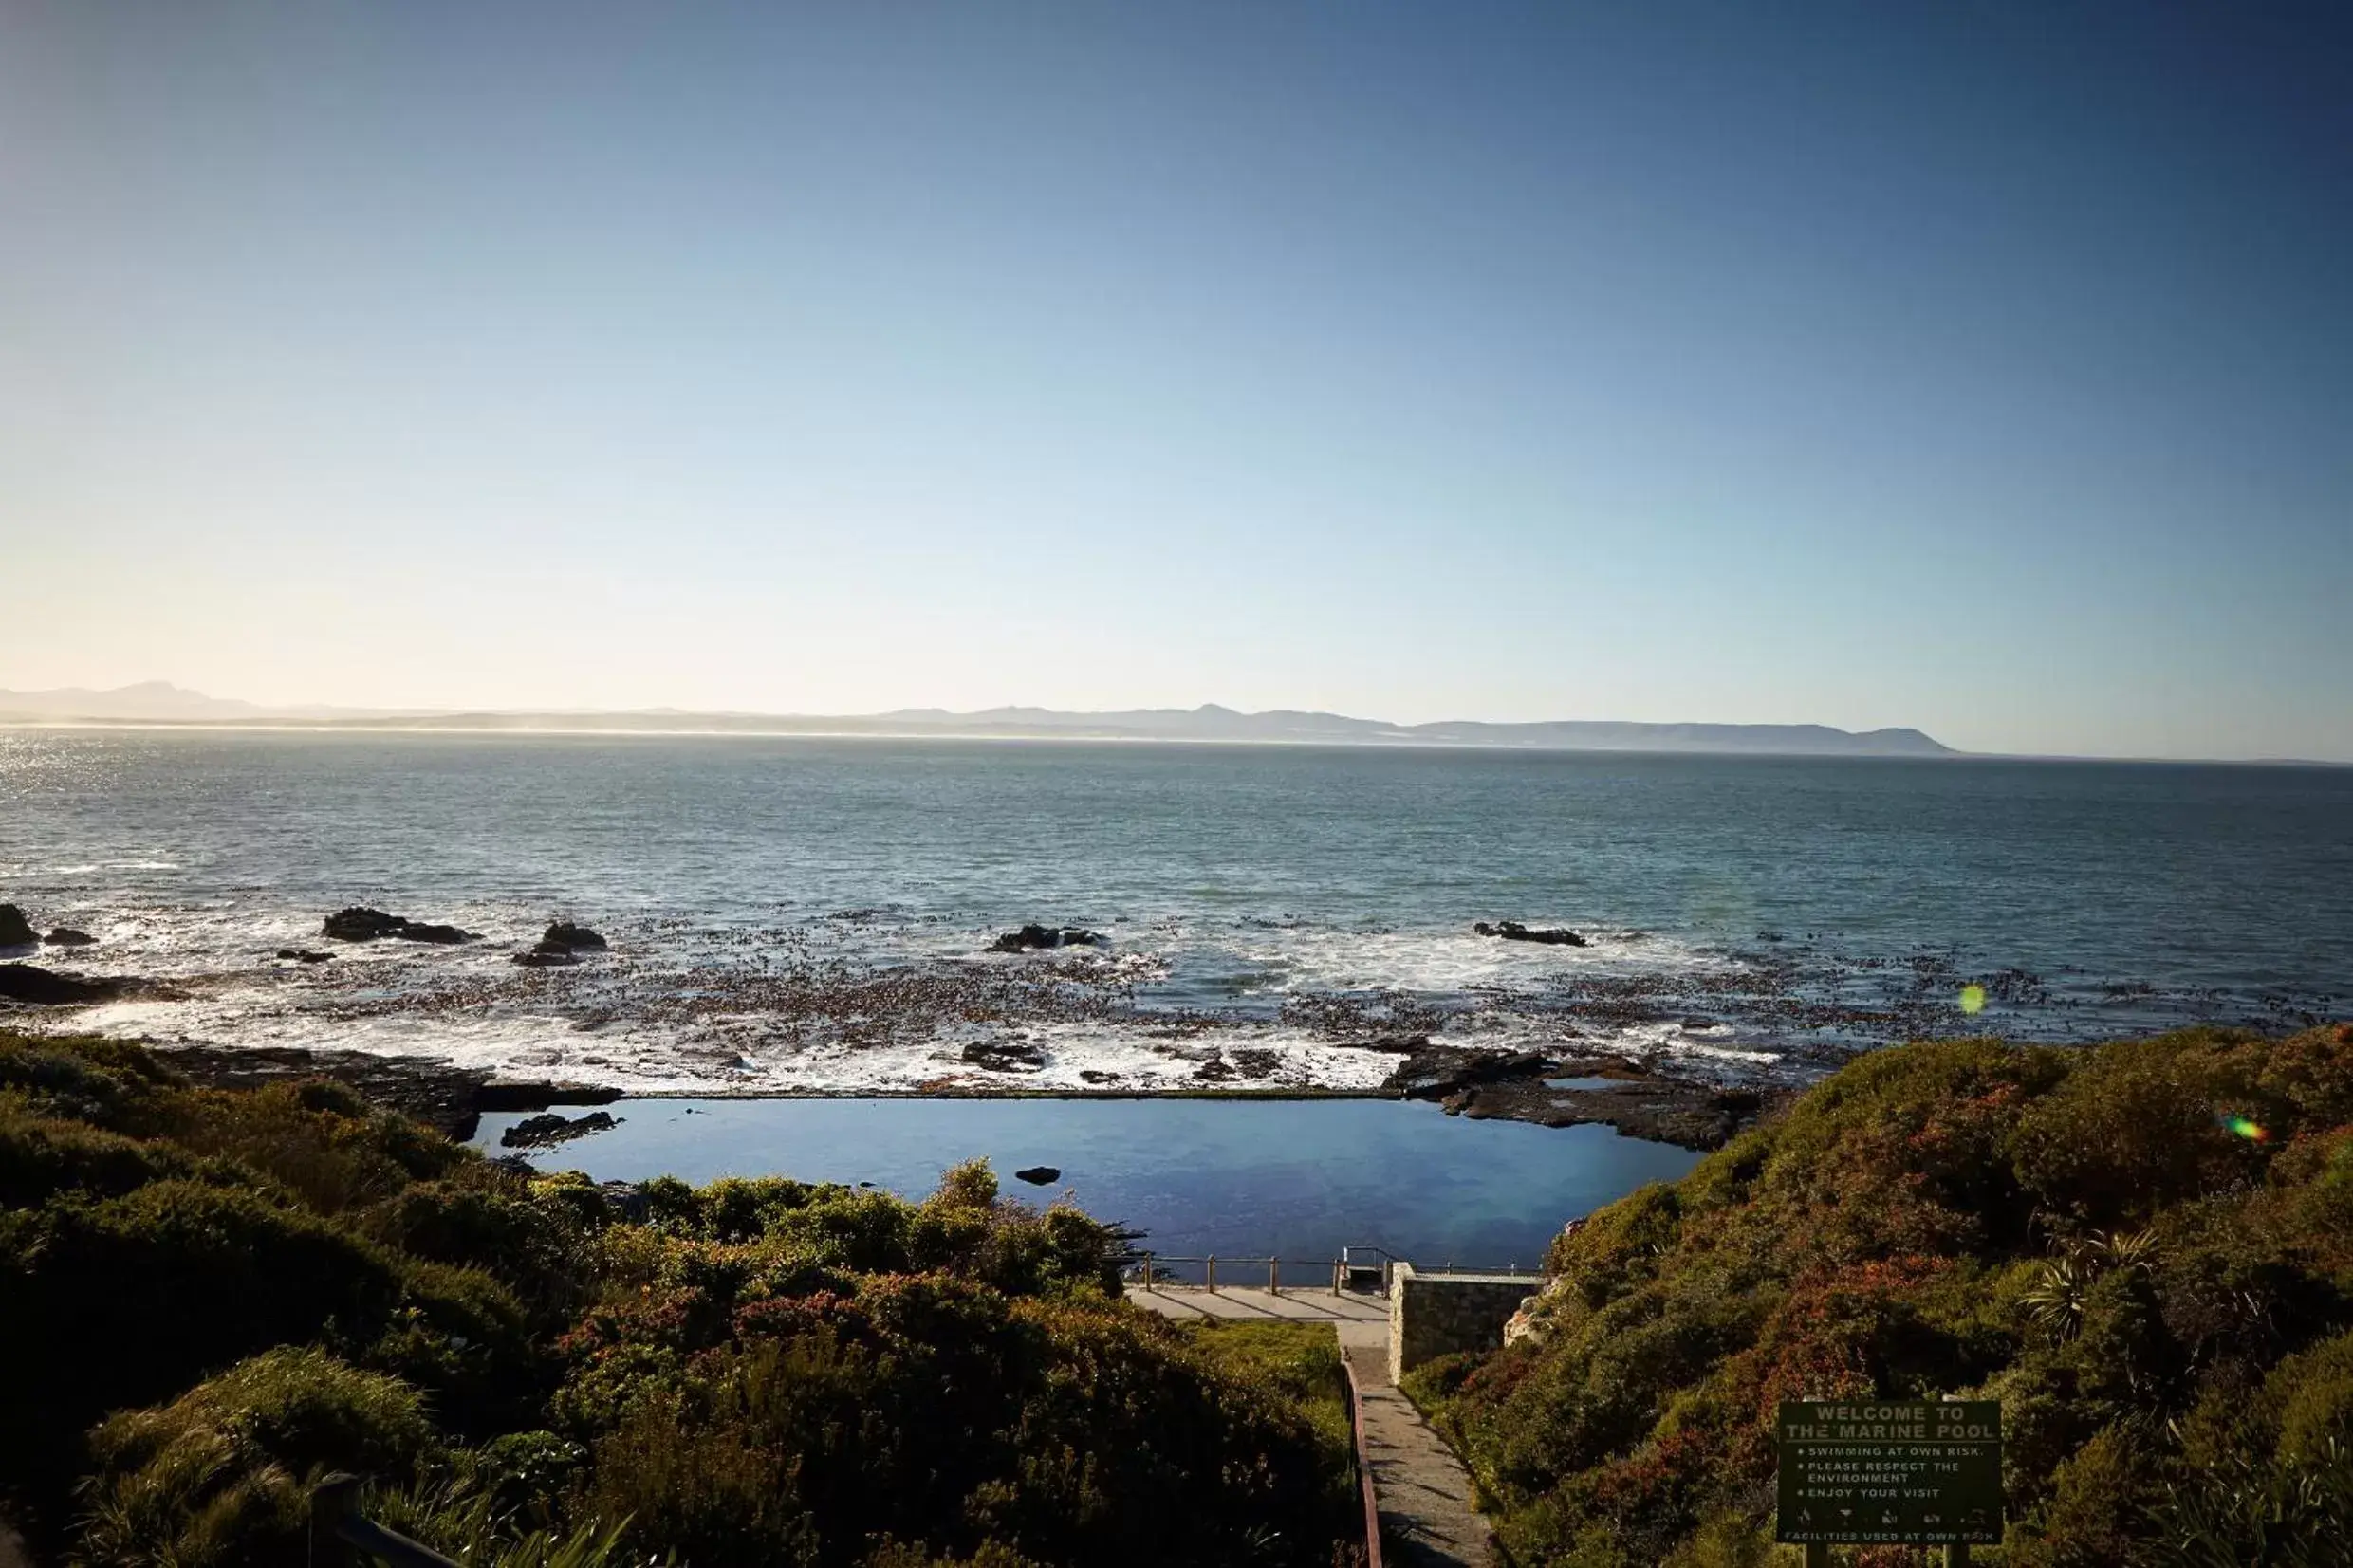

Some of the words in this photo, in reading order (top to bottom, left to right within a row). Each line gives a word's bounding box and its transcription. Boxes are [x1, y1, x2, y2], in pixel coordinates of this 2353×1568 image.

[1817, 1406, 1927, 1421] WELCOME
[1937, 1407, 1964, 1421] TO
[1786, 1424, 1829, 1438] THE
[1839, 1424, 1926, 1438] MARINE
[1937, 1424, 1994, 1438] POOL
[1808, 1448, 1881, 1456] SWIMMING
[1888, 1448, 1904, 1456] AT
[1910, 1448, 1941, 1456] OWN
[1948, 1448, 1984, 1456] RISK.
[1808, 1462, 1859, 1471] PLEASE
[1866, 1462, 1927, 1472] RESPECT
[1934, 1462, 1959, 1472] THE
[1808, 1473, 1909, 1483] ENVIRONMENT
[1808, 1488, 1852, 1498] ENJOY
[1861, 1488, 1898, 1498] YOUR
[1904, 1488, 1940, 1498] VISIT
[1784, 1532, 1857, 1540] FACILITIES
[1863, 1532, 1899, 1540] USED
[1905, 1532, 1919, 1540] AT
